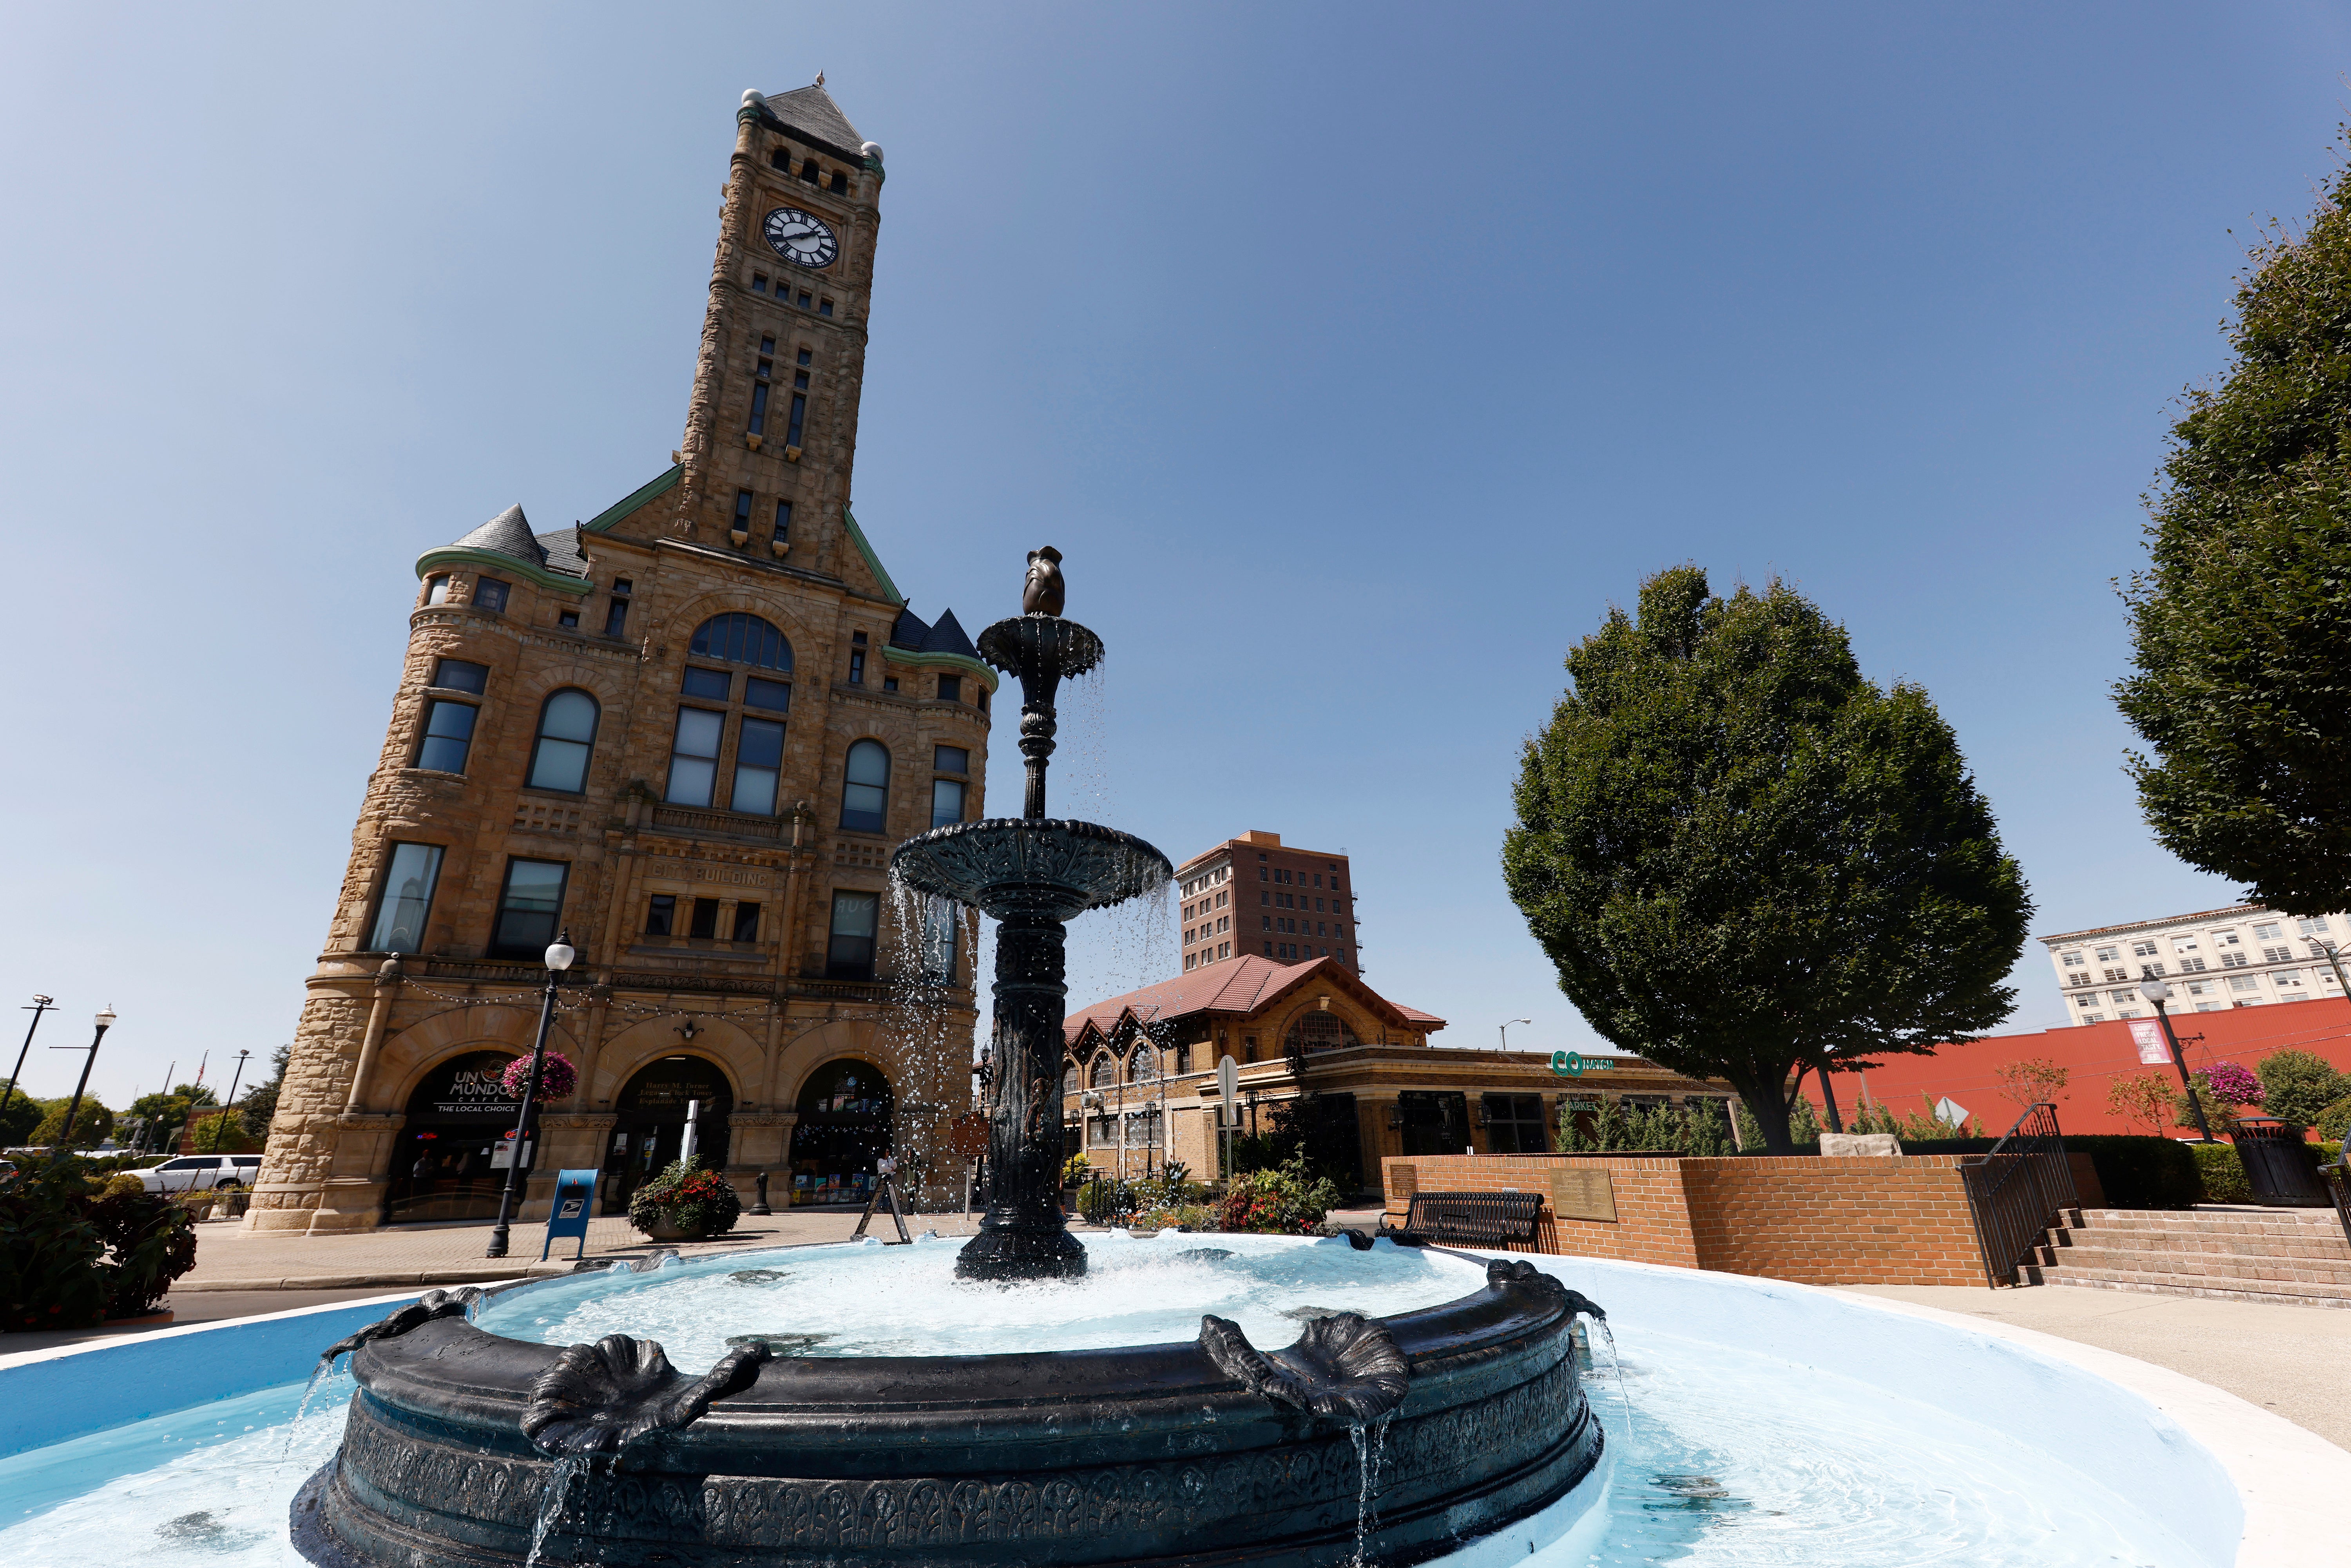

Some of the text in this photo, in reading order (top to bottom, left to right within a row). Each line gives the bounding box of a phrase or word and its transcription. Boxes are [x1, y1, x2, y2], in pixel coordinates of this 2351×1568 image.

[652, 863, 767, 887] CITY BUILDING
[455, 1072, 478, 1083] UN
[449, 1083, 508, 1095] MUNDO
